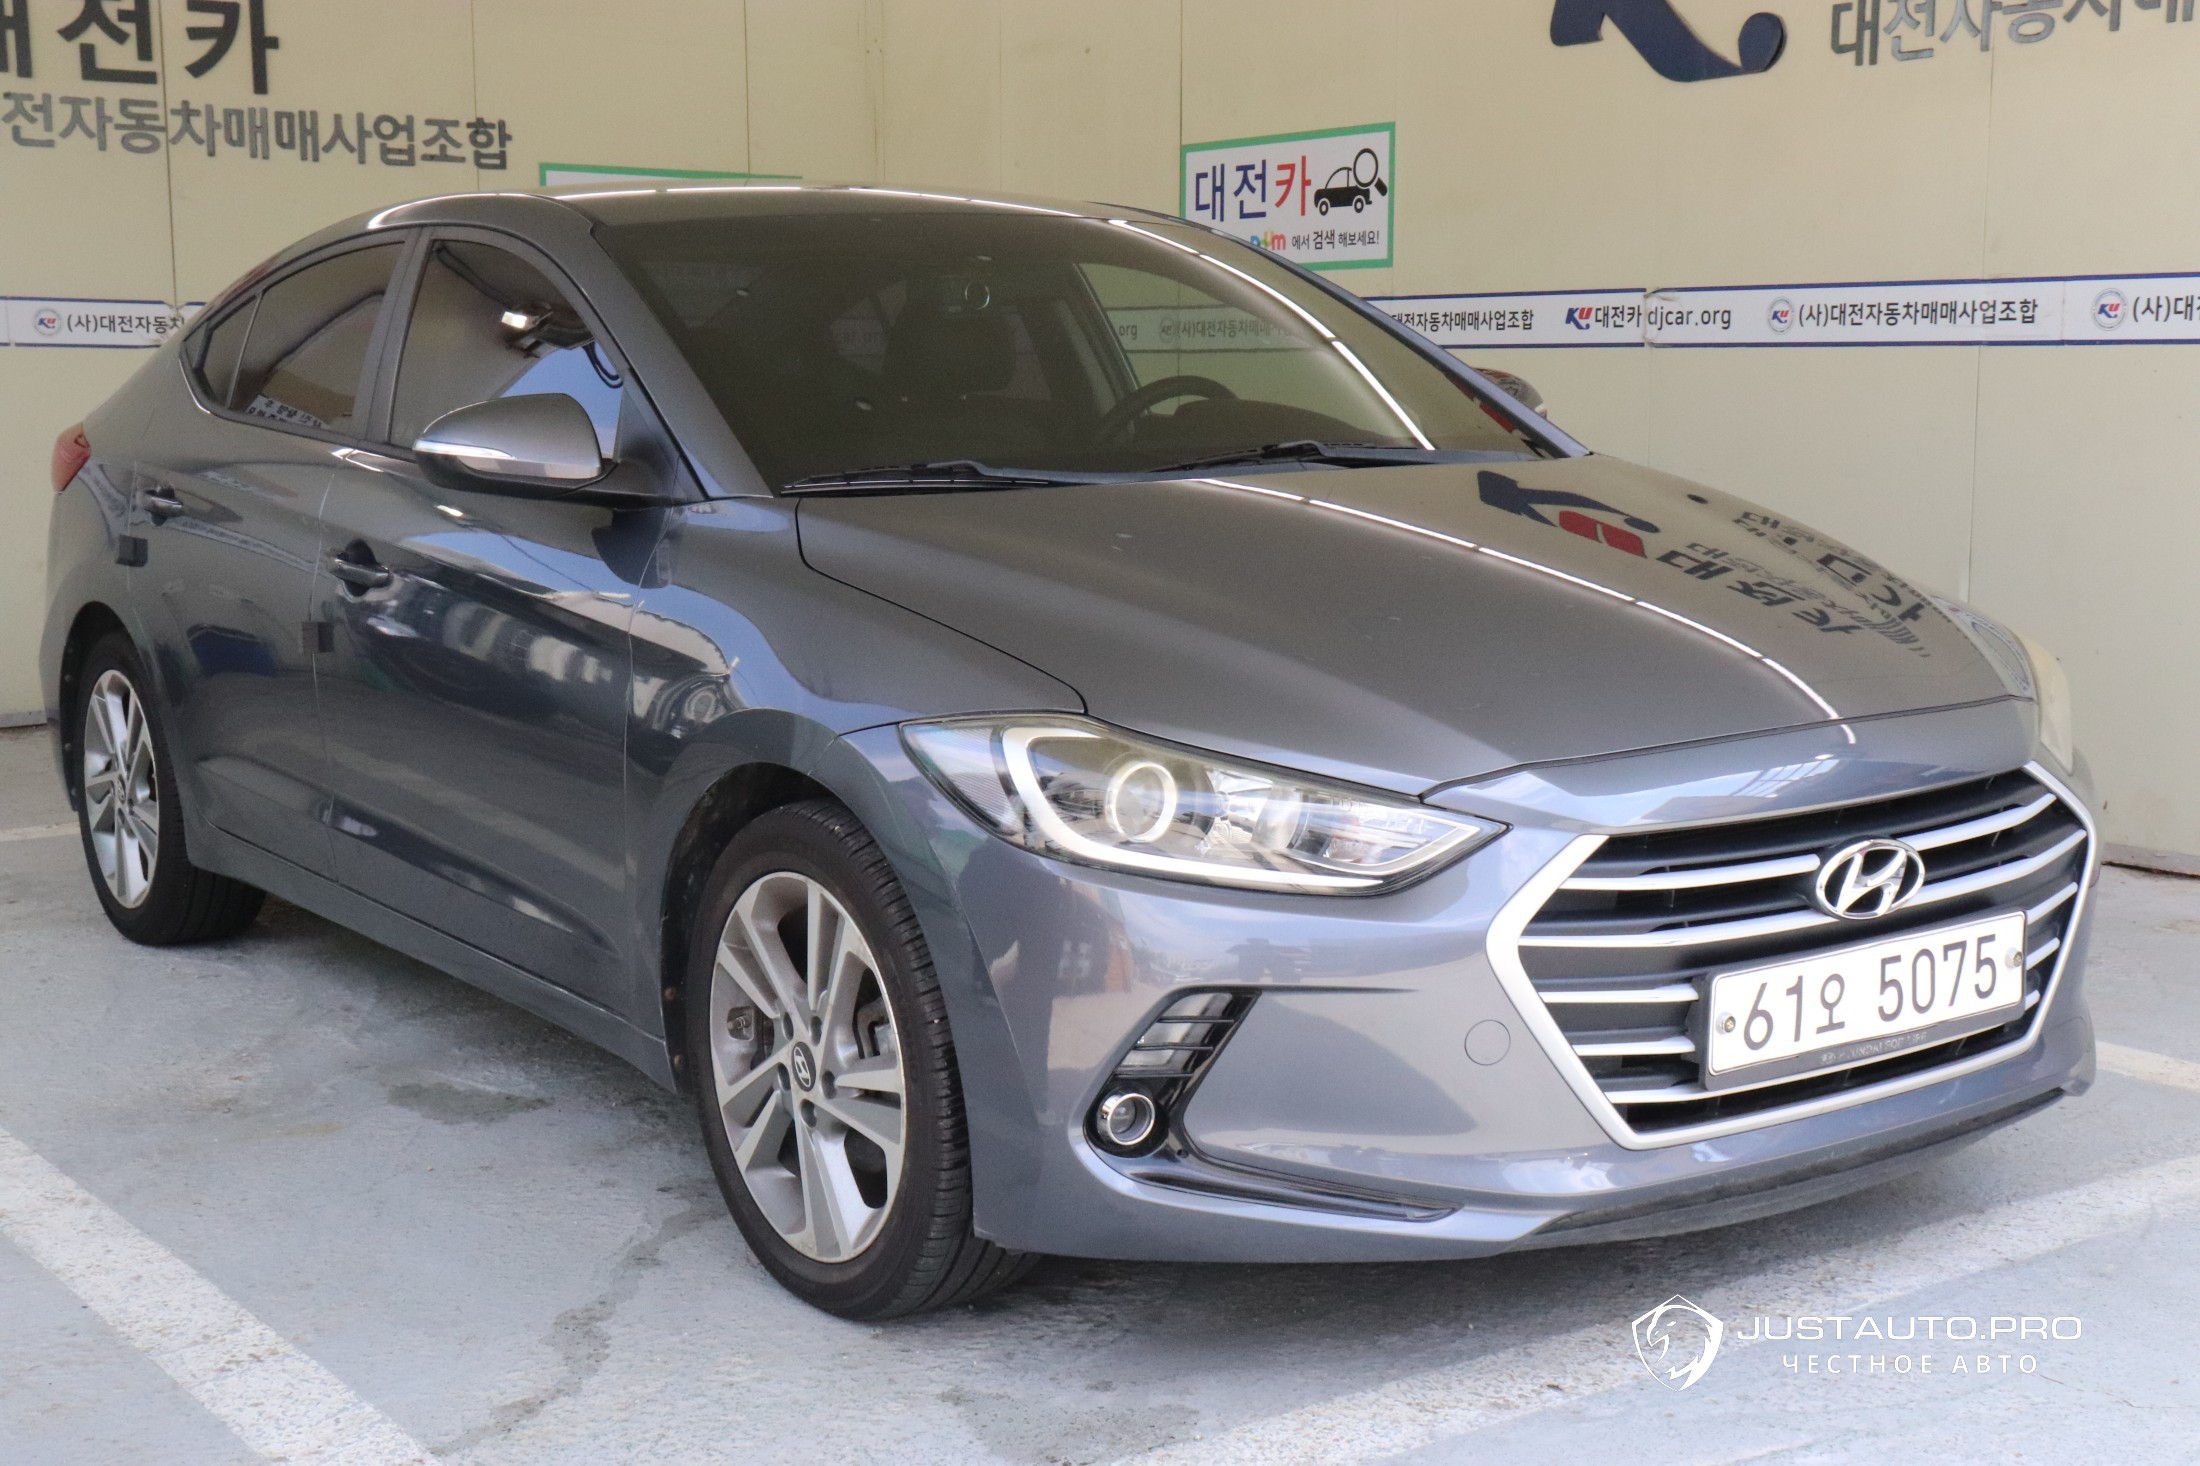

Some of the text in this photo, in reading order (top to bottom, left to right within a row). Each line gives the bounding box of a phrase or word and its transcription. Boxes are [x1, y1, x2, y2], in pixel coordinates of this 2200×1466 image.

[1, 91, 513, 170] 전자동차매매사업조합
[1195, 155, 1312, 222] 대전카
[1291, 234, 1310, 250] 에서
[1313, 229, 1335, 250] 검색
[1338, 230, 1380, 247] 해보세요!
[1595, 304, 1642, 328] 대전카
[1647, 306, 1732, 331] djcar.org
[1799, 299, 2039, 327] (사)대전자동차매매사업조합
[2133, 294, 2200, 322] (사)대
[1743, 932, 1998, 1051] 61오 5075
